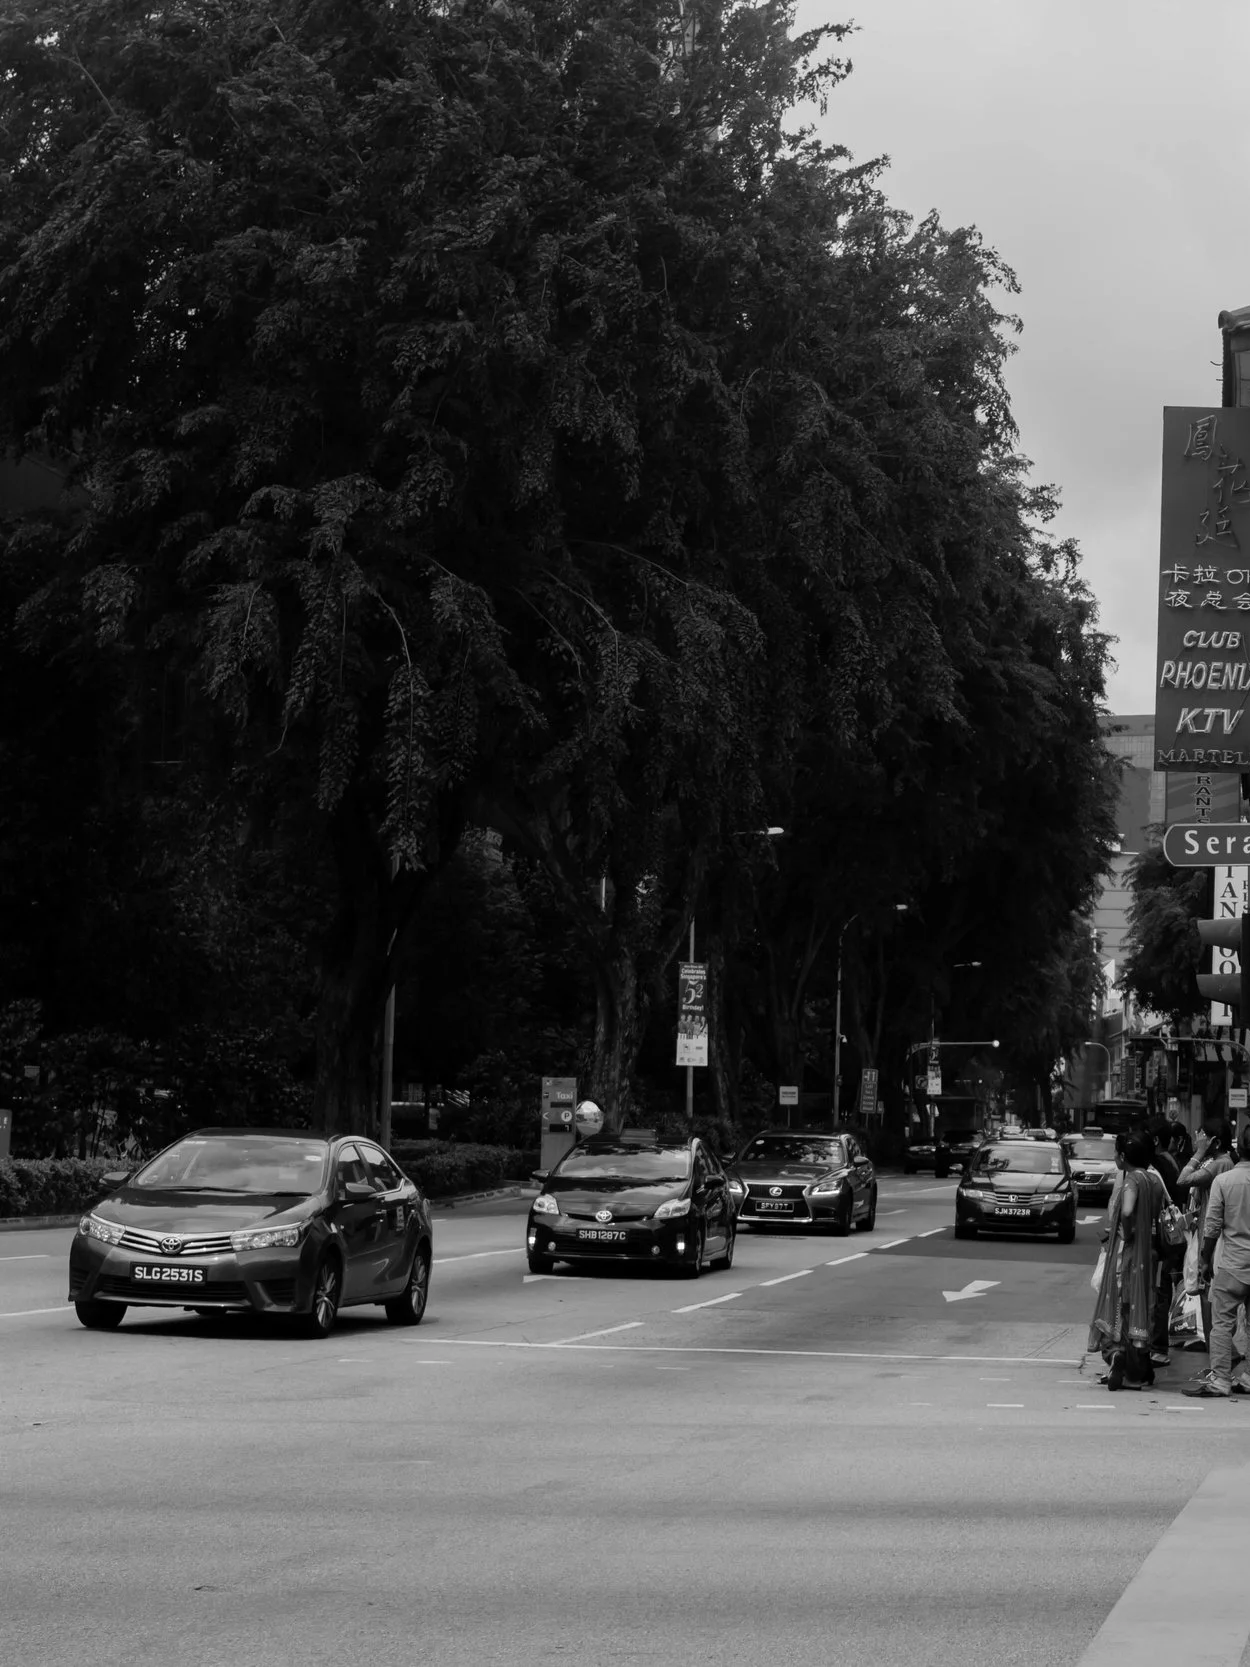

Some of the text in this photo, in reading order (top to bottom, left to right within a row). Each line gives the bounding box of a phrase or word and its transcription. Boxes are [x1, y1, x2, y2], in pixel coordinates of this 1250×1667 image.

[1183, 629, 1243, 649] CLUB
[1176, 707, 1245, 735] KTV
[556, 1091, 574, 1100] Taxi
[579, 1230, 627, 1241] SHB1287C
[134, 1266, 205, 1282] SLG2531S
